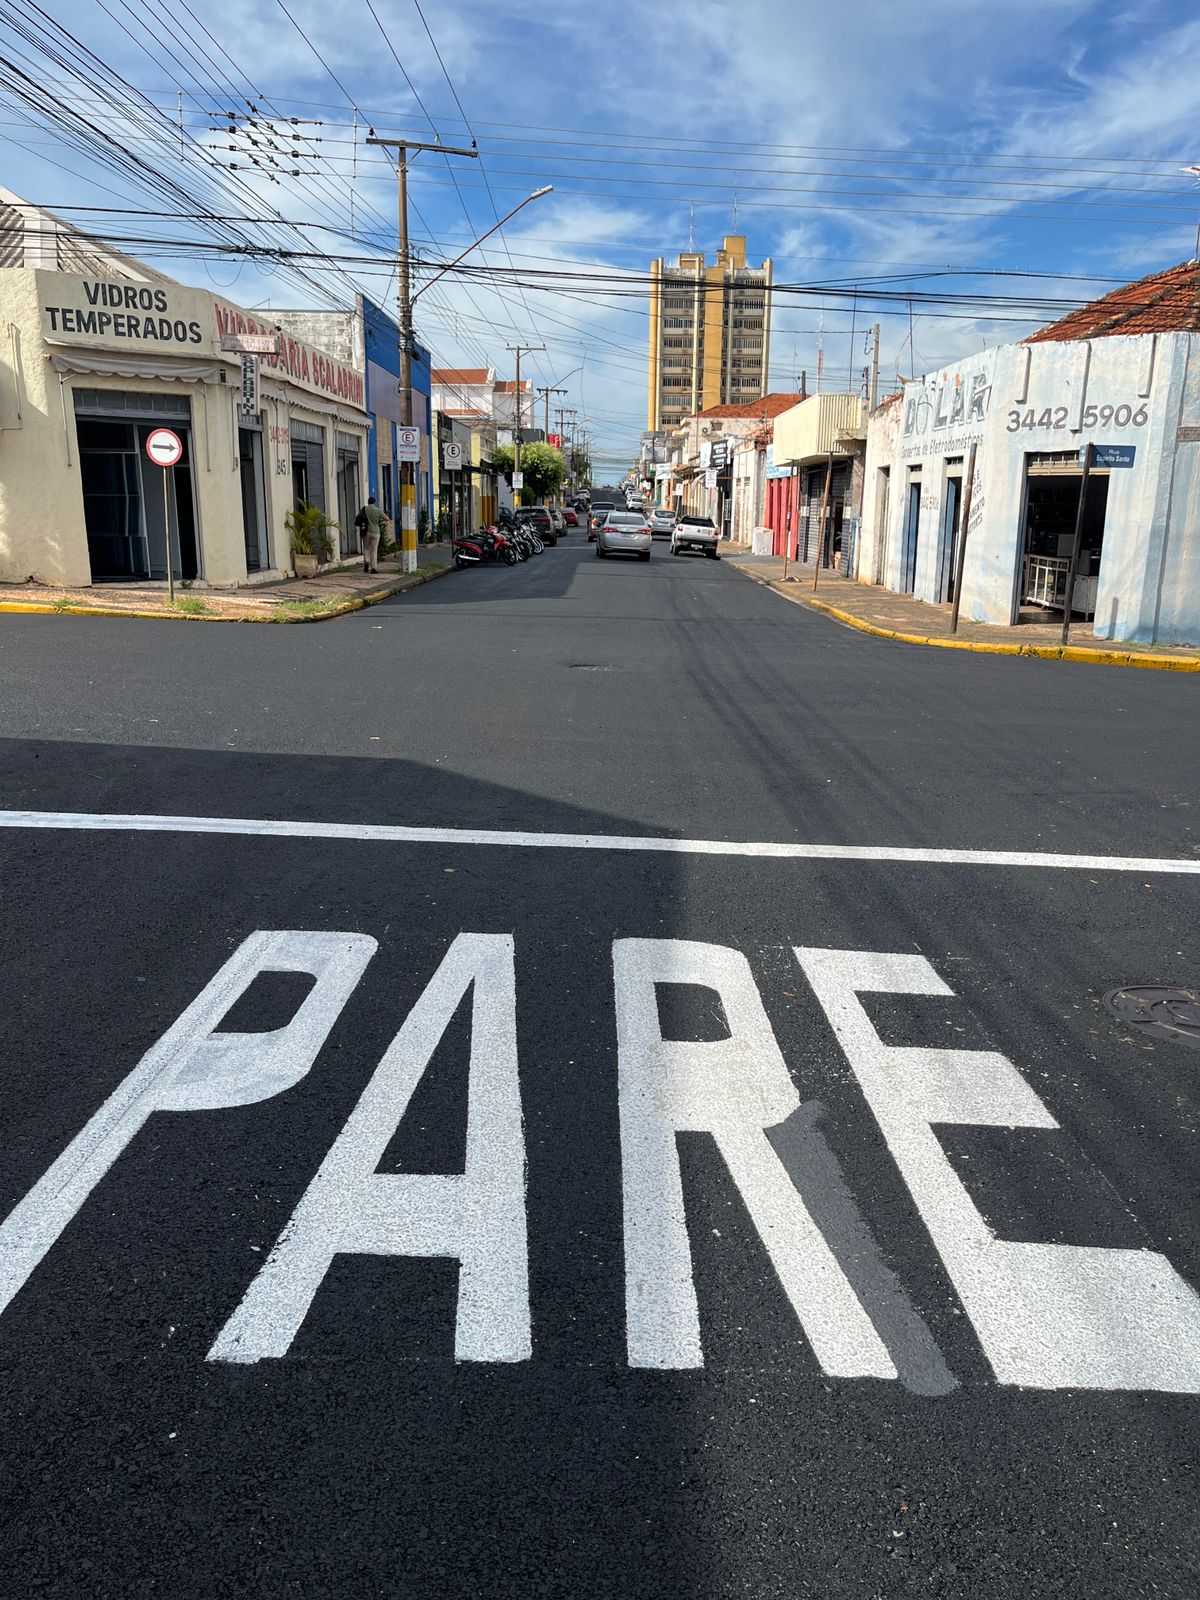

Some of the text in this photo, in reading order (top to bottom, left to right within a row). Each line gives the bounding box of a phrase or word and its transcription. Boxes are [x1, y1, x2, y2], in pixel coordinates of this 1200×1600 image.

[83, 281, 168, 313] VIDROS
[45, 307, 202, 344] TEMPERADOS
[312, 351, 364, 407] SCALABRINI
[1006, 403, 1148, 433] 3442 5906
[1115, 454, 1130, 463] Santo
[0, 930, 1200, 1392] PARE
